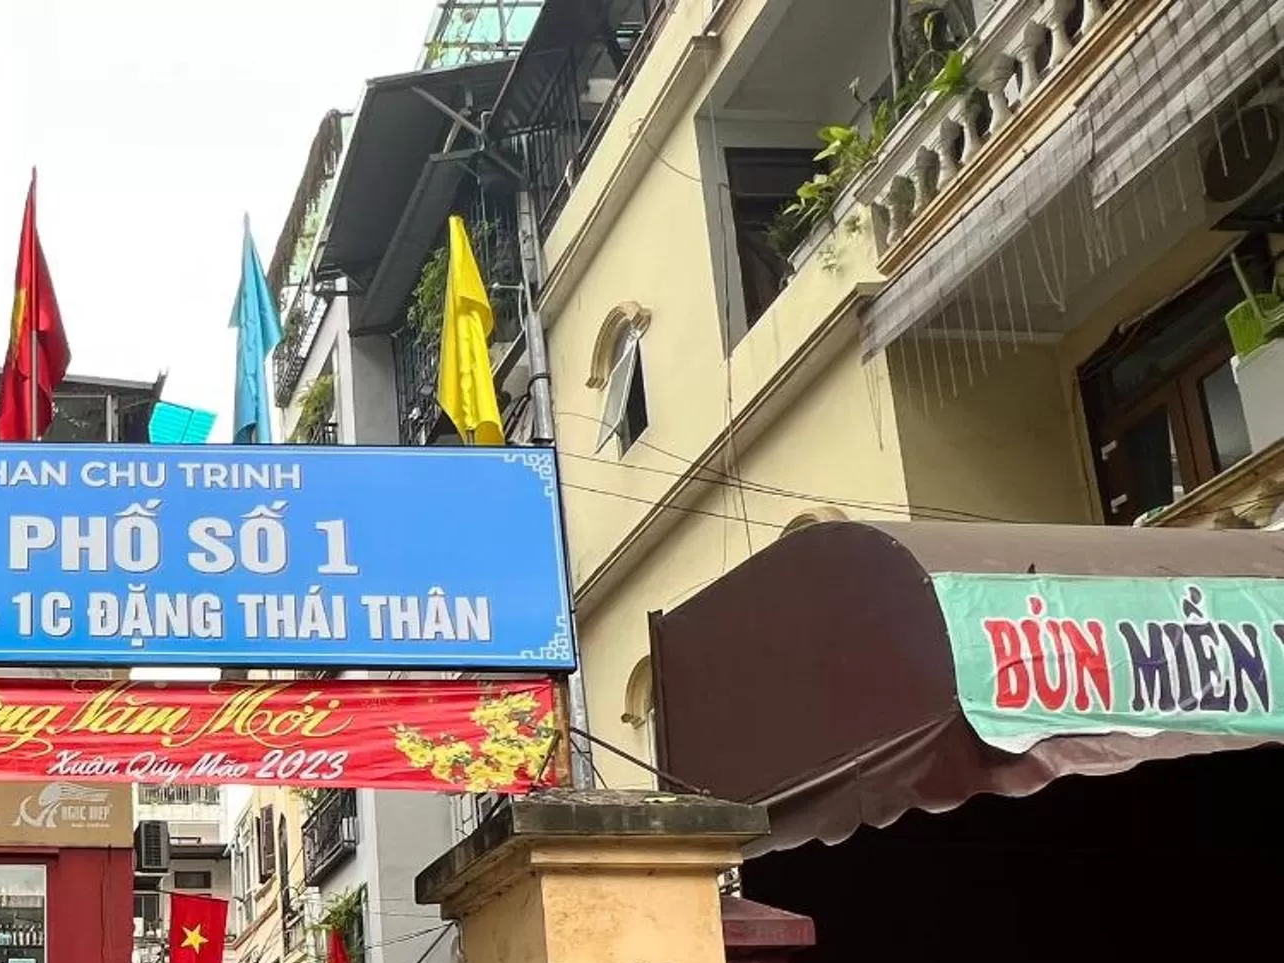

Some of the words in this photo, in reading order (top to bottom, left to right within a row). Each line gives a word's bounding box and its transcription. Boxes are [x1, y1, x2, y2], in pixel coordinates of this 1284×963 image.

[80, 461, 166, 490] CHU
[178, 463, 303, 491] TRINH
[9, 499, 163, 574] PHỐ
[187, 500, 289, 576] SỐ
[315, 519, 360, 576] 1
[12, 592, 72, 638] 1C
[87, 584, 223, 648] ĐẶNG
[237, 585, 348, 640] THÁI
[361, 586, 491, 643] THÂN
[983, 595, 1114, 712] BÚN
[49, 680, 192, 734] Năm
[162, 680, 354, 748] Mới
[255, 749, 349, 781] 2023
